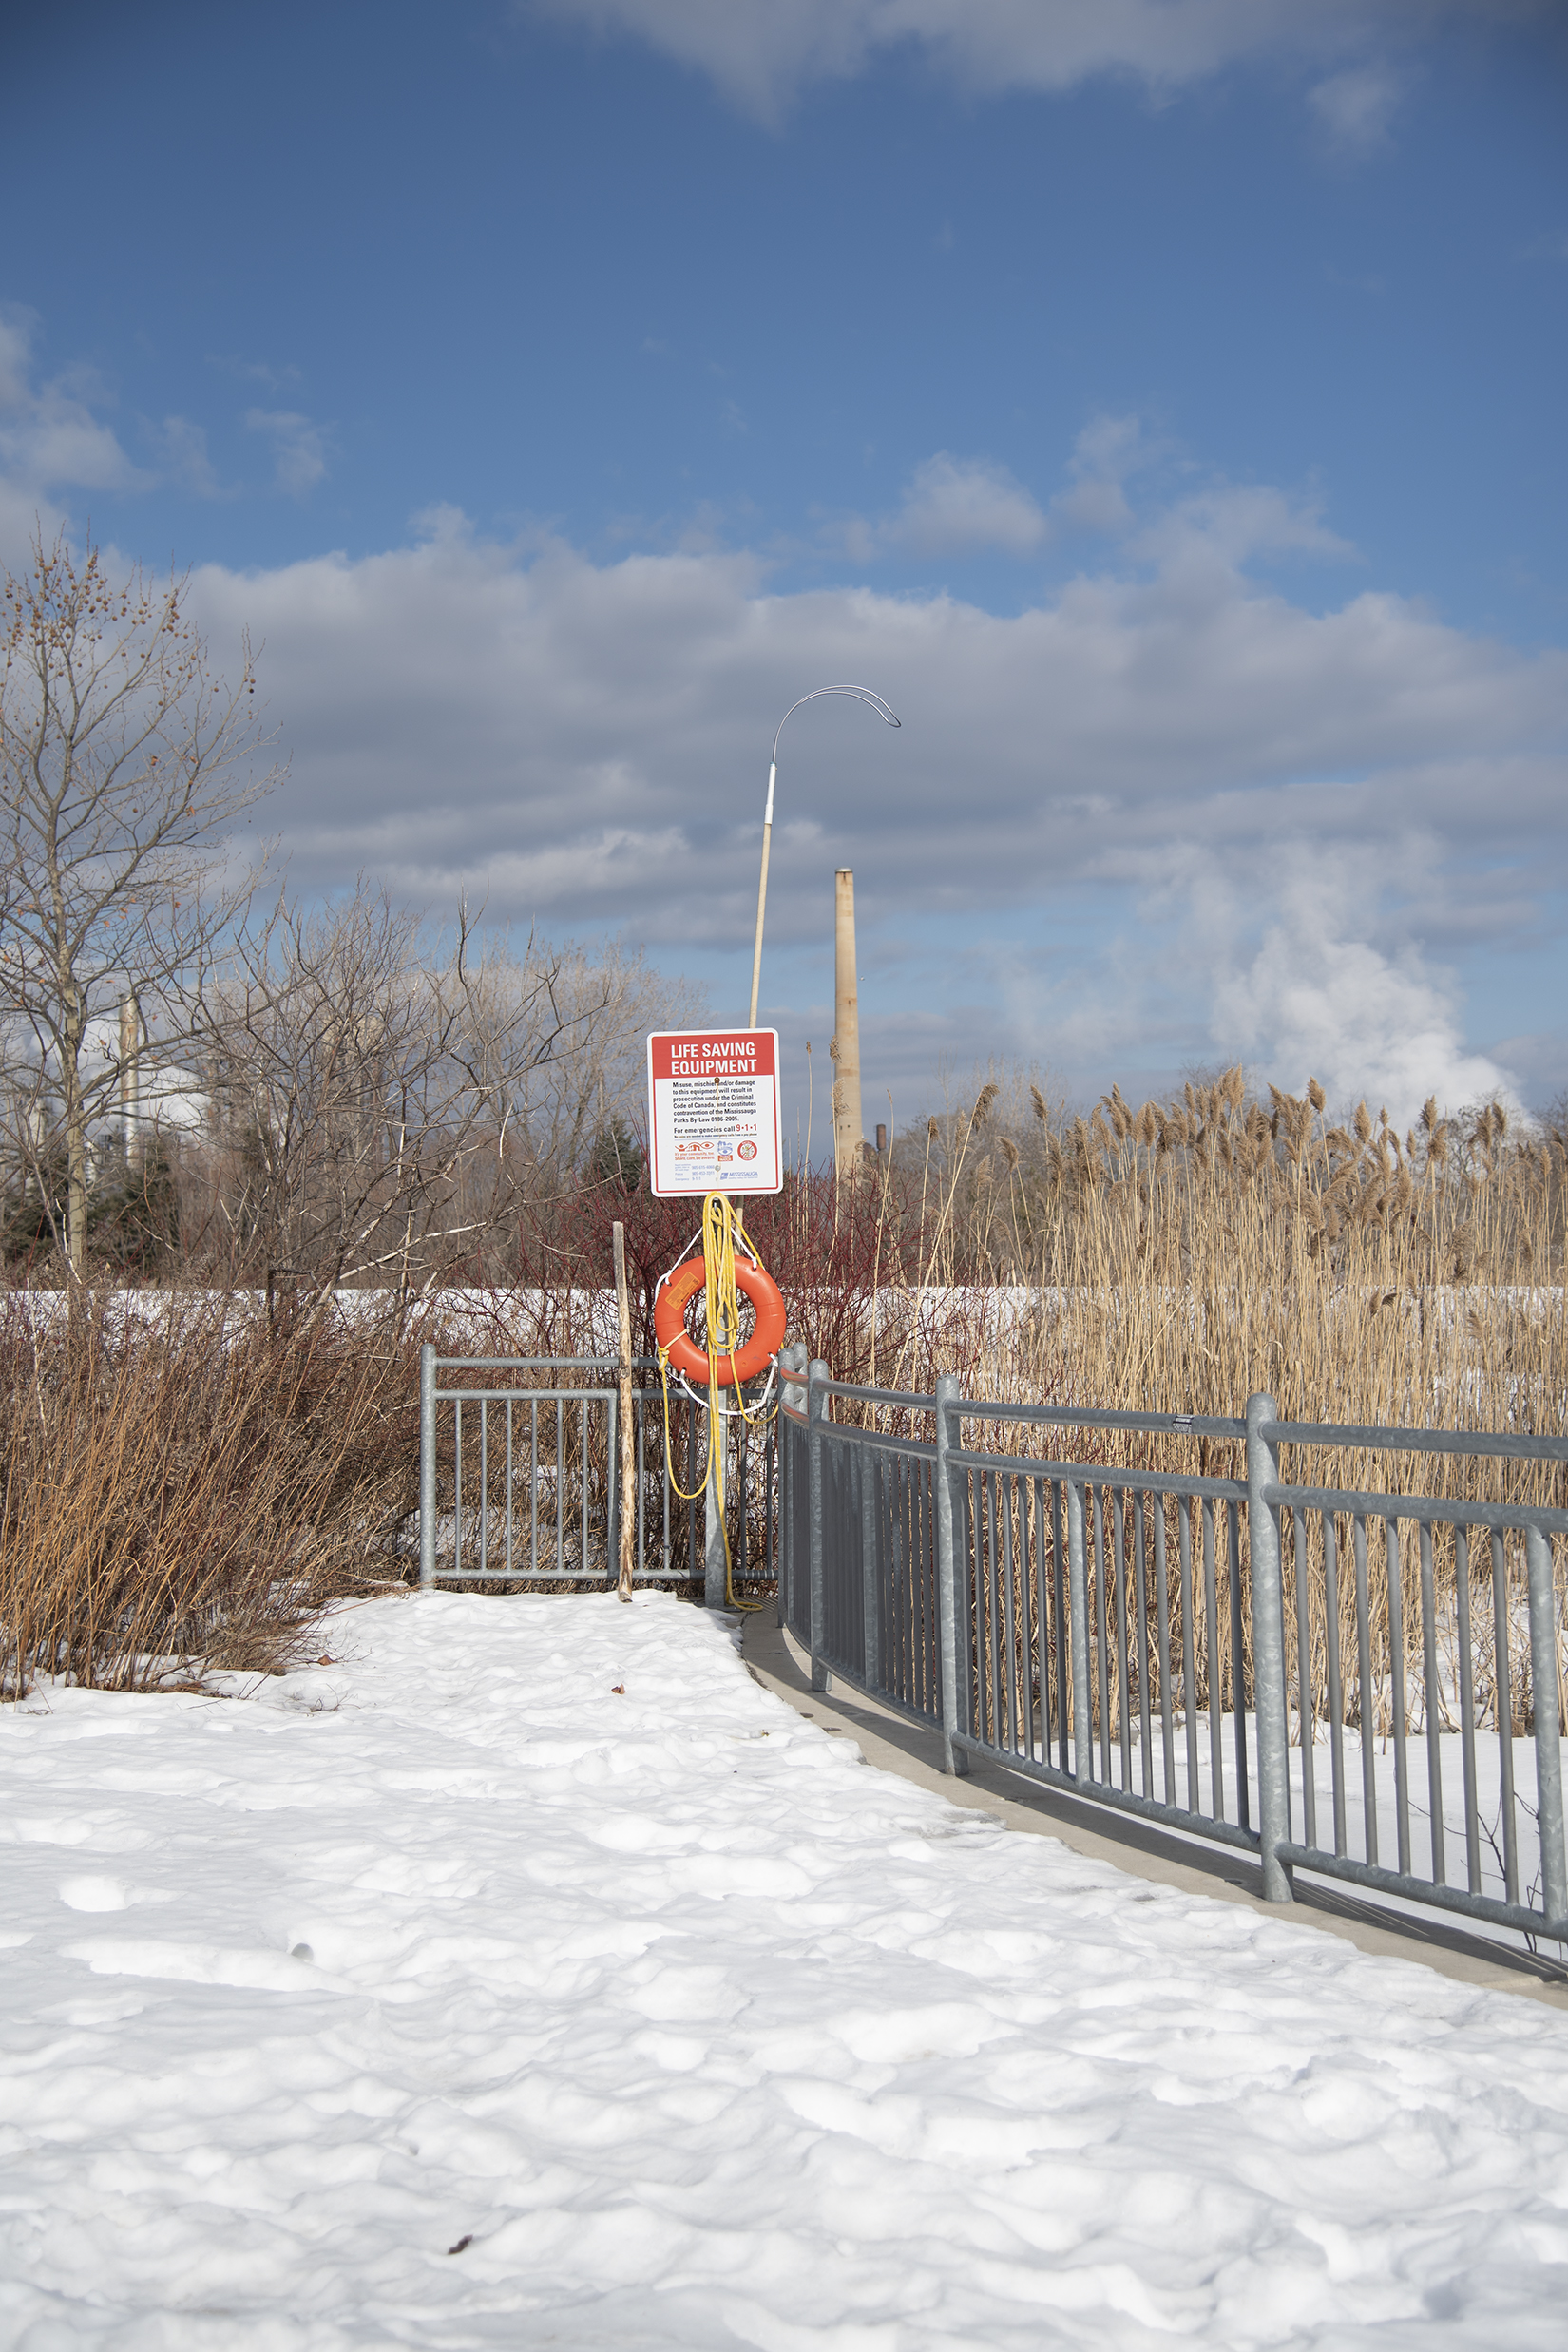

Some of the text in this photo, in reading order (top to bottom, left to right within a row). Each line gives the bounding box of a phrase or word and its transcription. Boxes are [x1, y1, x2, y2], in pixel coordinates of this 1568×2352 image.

[671, 1042, 755, 1059] LIFE SAVING
[671, 1059, 757, 1075] EQUIPMENT
